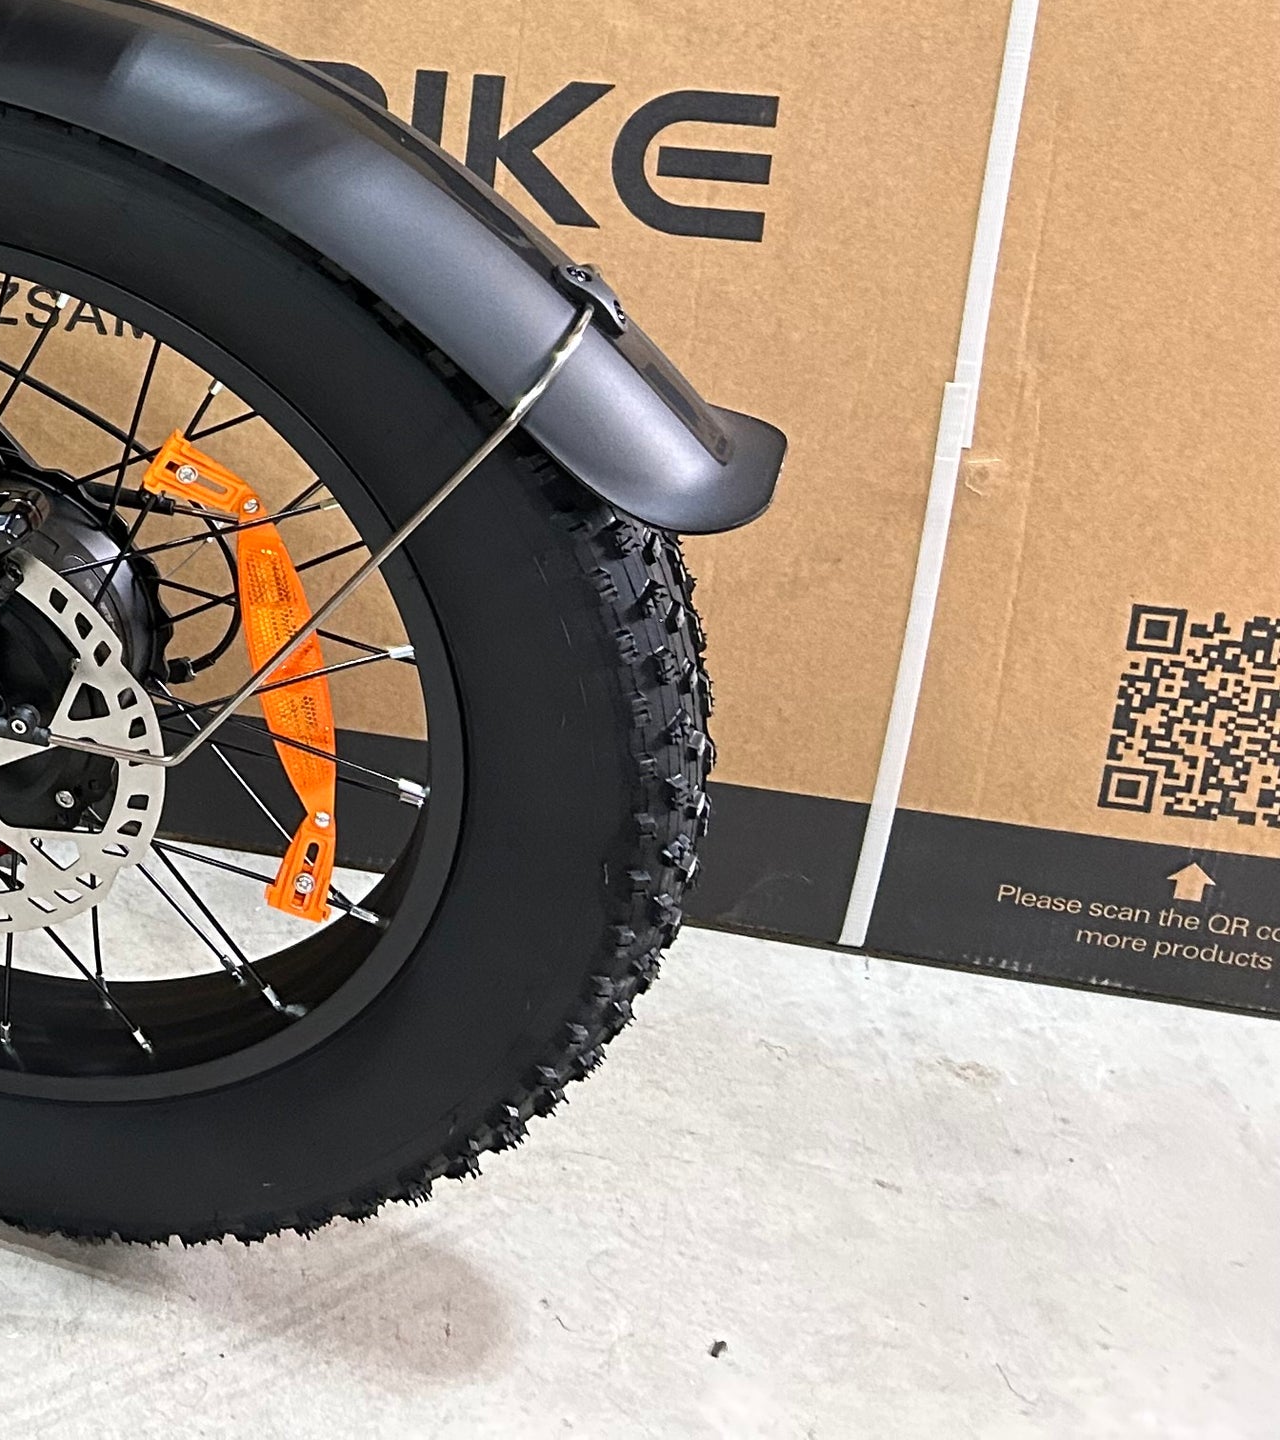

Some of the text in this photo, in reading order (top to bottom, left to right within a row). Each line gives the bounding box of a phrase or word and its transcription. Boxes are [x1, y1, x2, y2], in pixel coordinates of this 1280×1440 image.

[996, 884, 1082, 914] Please
[1088, 901, 1151, 924] scan
[1158, 908, 1201, 931] the
[1208, 914, 1251, 937] QR
[1075, 928, 1274, 971] more products
